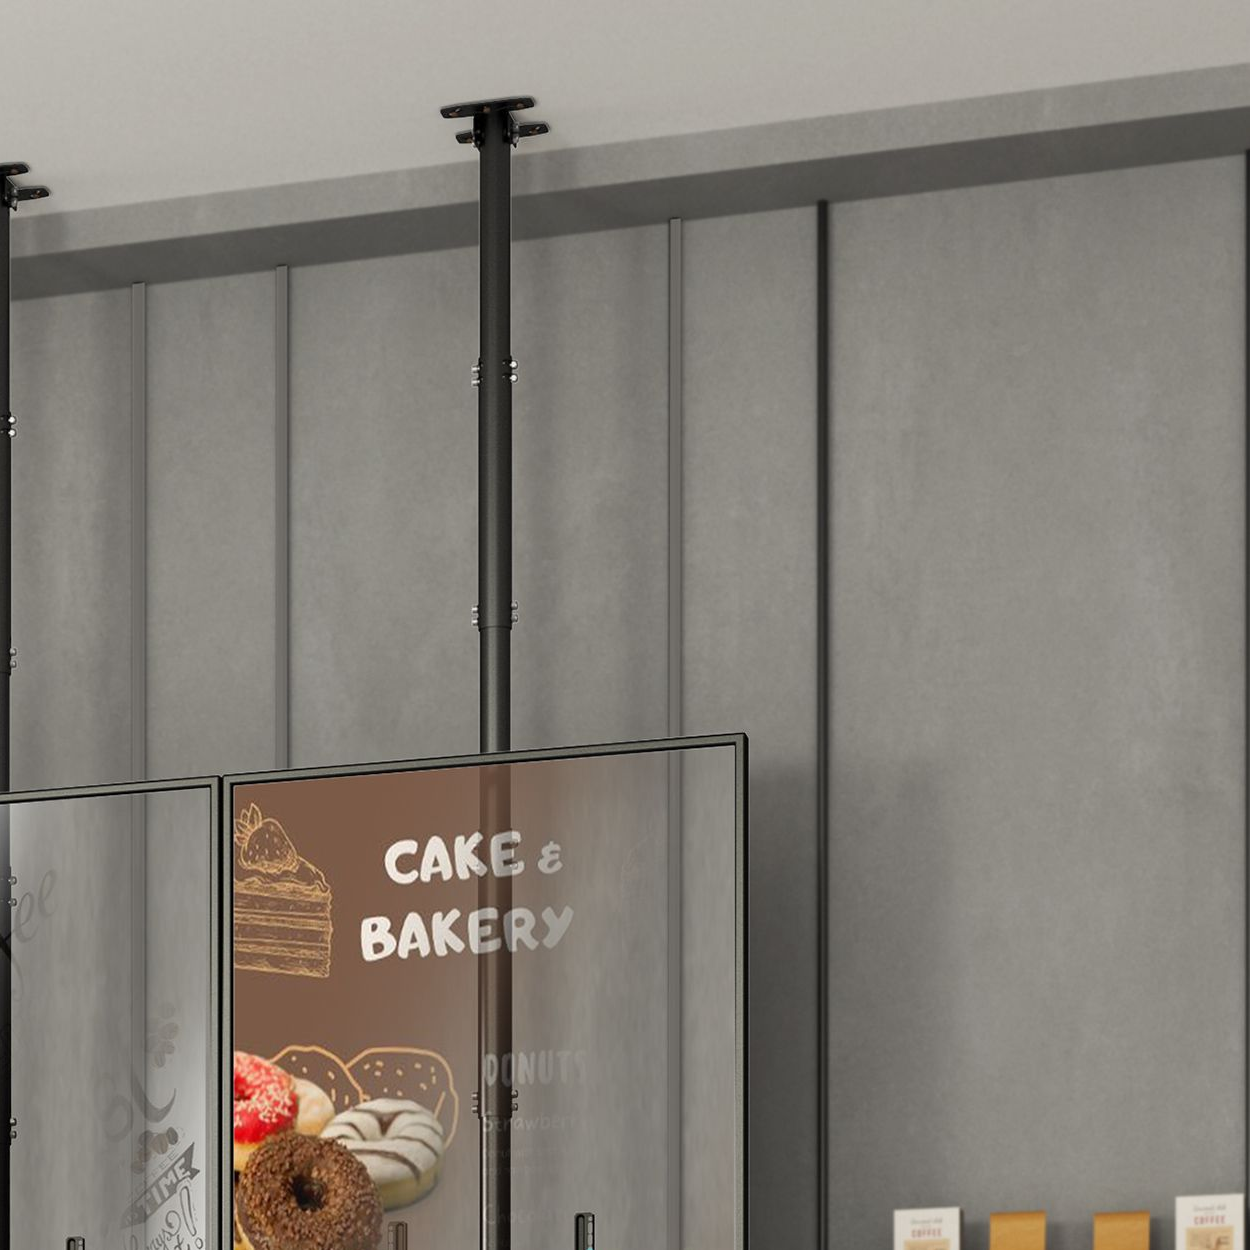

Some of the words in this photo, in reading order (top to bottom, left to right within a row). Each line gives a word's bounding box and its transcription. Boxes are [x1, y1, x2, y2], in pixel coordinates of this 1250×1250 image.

[384, 831, 525, 885] CAKE
[537, 841, 564, 874] &
[359, 904, 575, 963] BAKERY
[485, 1049, 588, 1088] DONUTS
[911, 1228, 943, 1239] COFFEE
[1193, 1215, 1226, 1226] COFFEE
